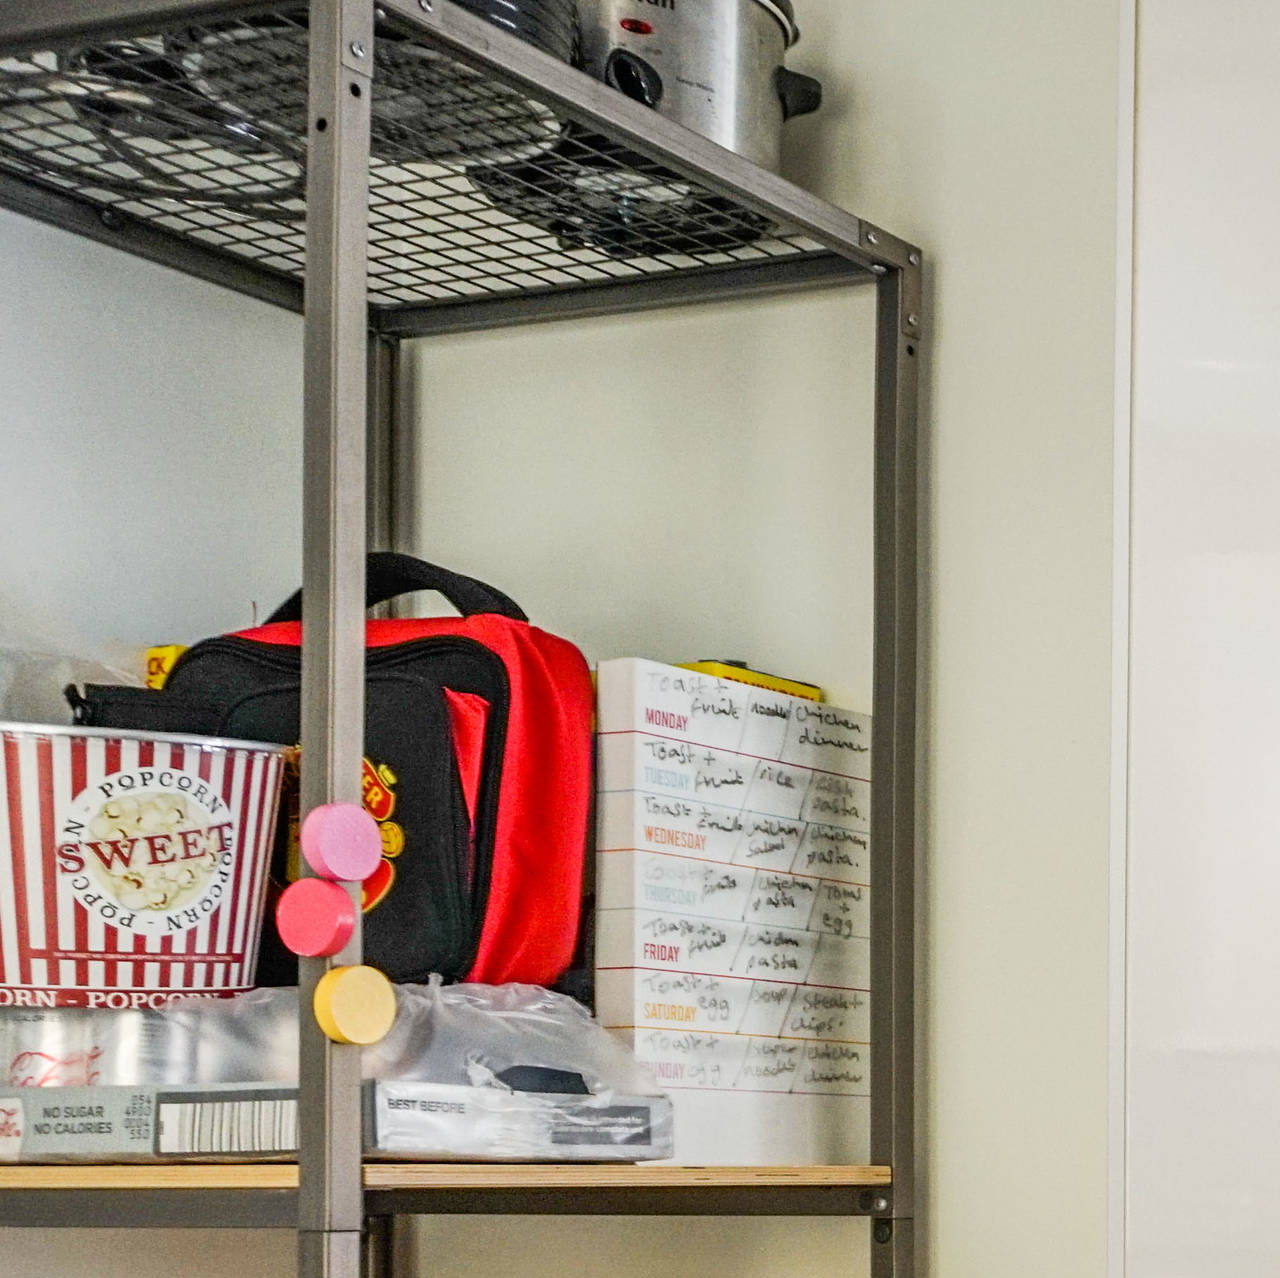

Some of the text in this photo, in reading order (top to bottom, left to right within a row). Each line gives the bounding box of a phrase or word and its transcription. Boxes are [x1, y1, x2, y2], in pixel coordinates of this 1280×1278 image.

[645, 708, 688, 731] MONDAY
[644, 766, 690, 790] TUESDAY
[98, 771, 223, 814] POPCORN
[56, 822, 233, 874] SWEET
[644, 825, 707, 851] WEDNESDAY
[643, 943, 680, 962] FRIDAY
[643, 1002, 697, 1022] SATURDAY
[42, 1105, 105, 1118] NO SUGAR
[387, 1098, 466, 1114] BEST BEFORE
[34, 1122, 113, 1135] NO CALORIES
